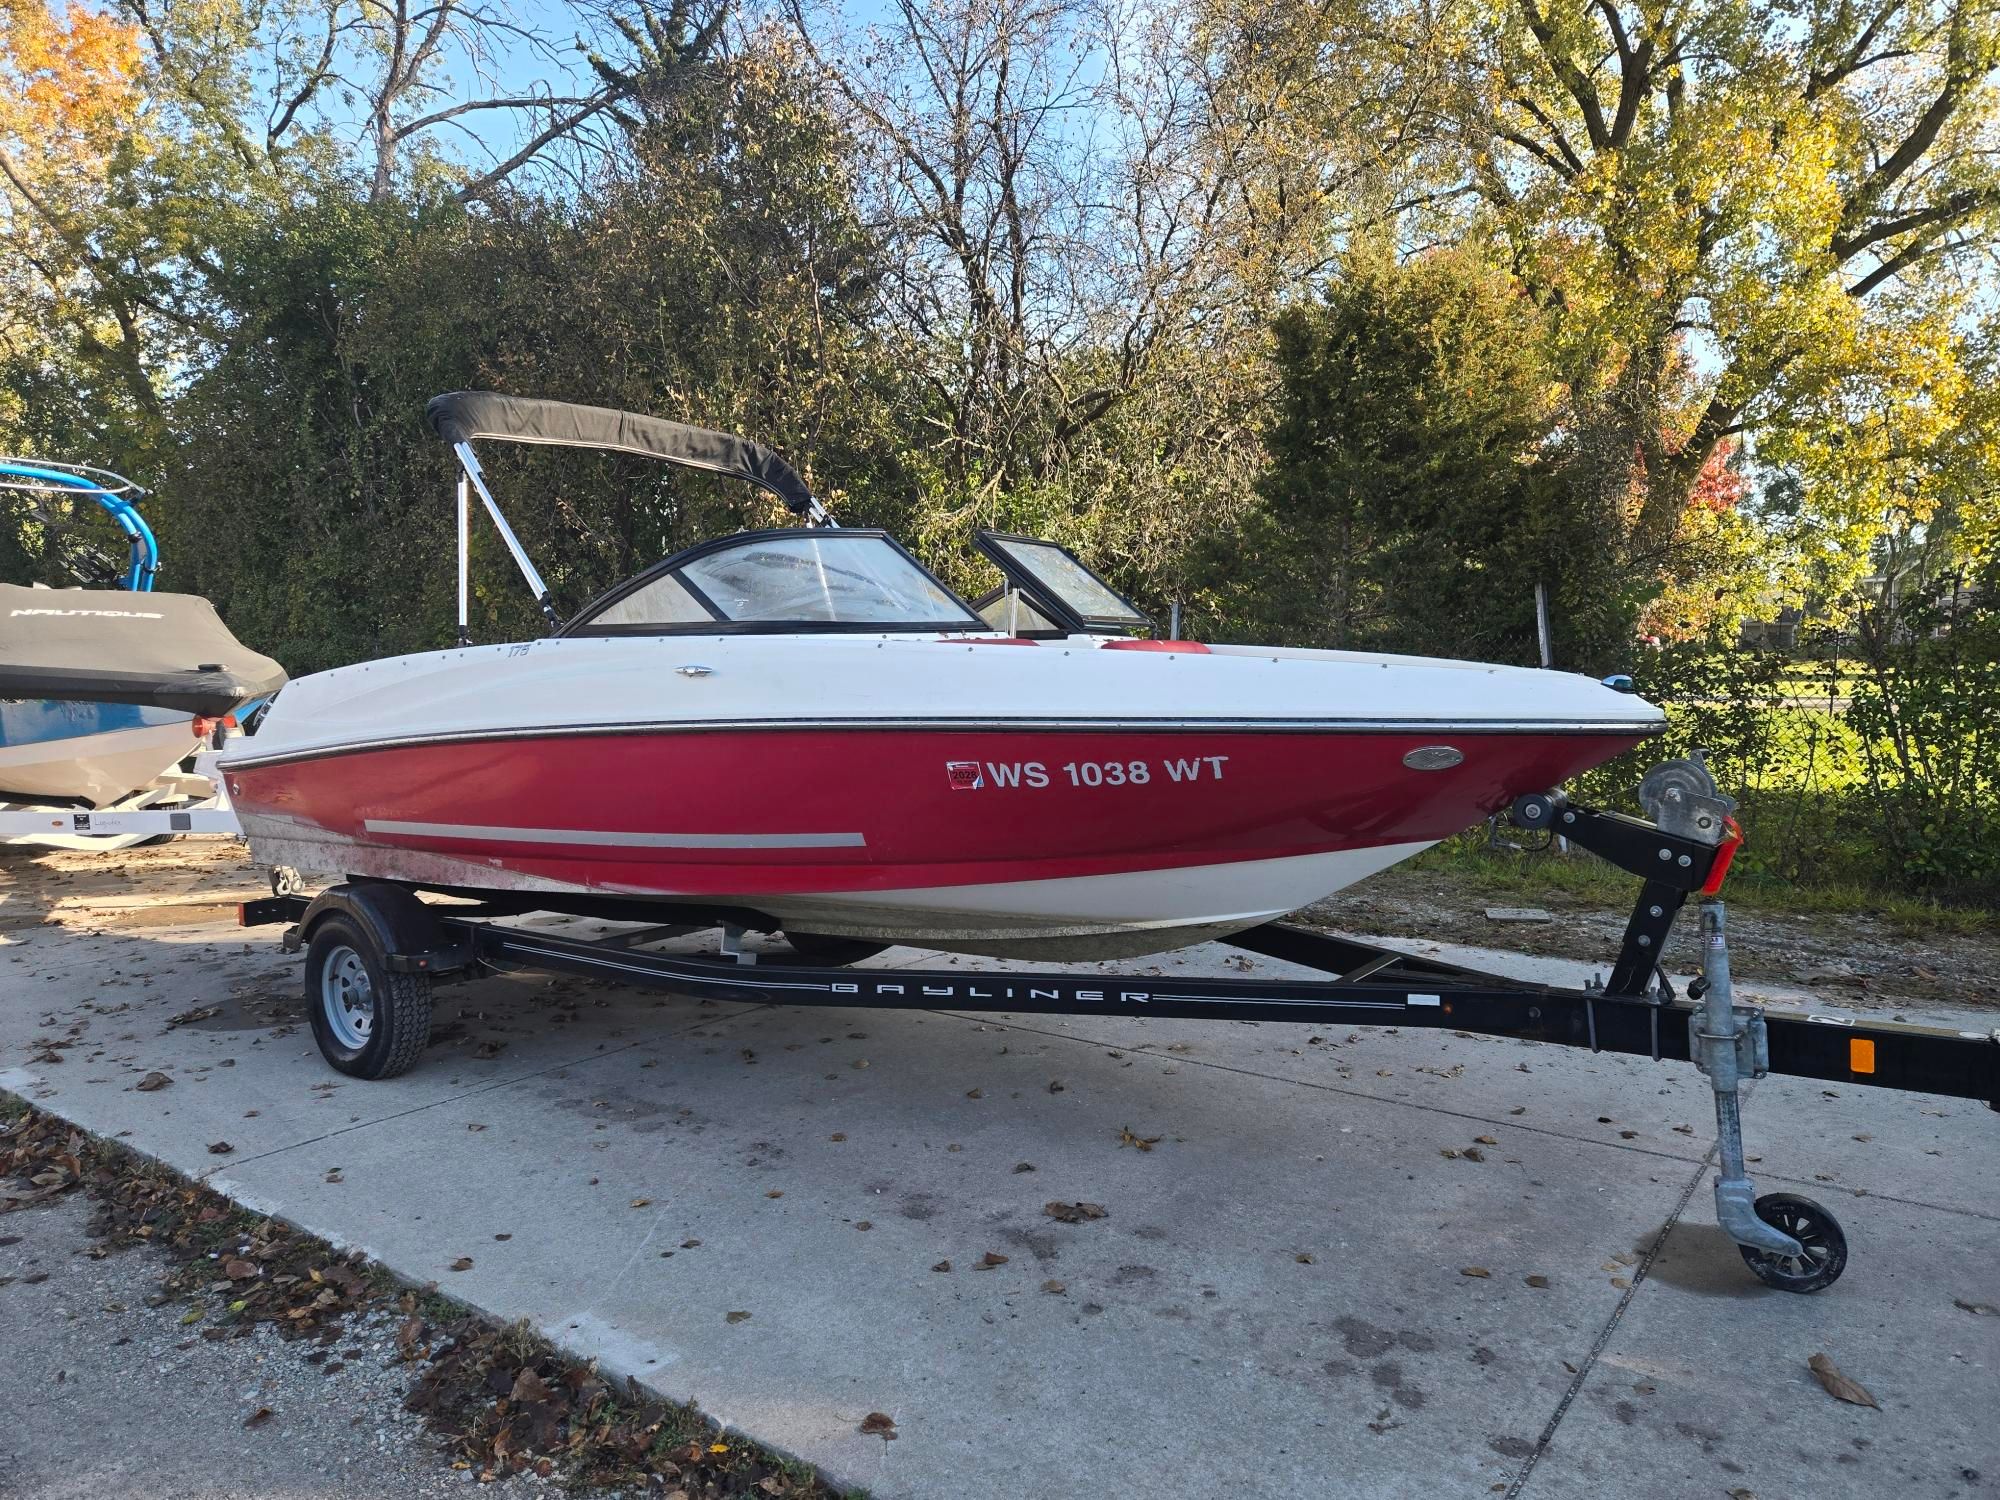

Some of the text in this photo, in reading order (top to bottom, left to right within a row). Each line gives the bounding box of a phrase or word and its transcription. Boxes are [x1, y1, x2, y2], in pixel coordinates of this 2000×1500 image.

[508, 644, 531, 658] 175
[986, 755, 1230, 788] WS 1038 WT
[831, 983, 1150, 1003] BAYLINER
